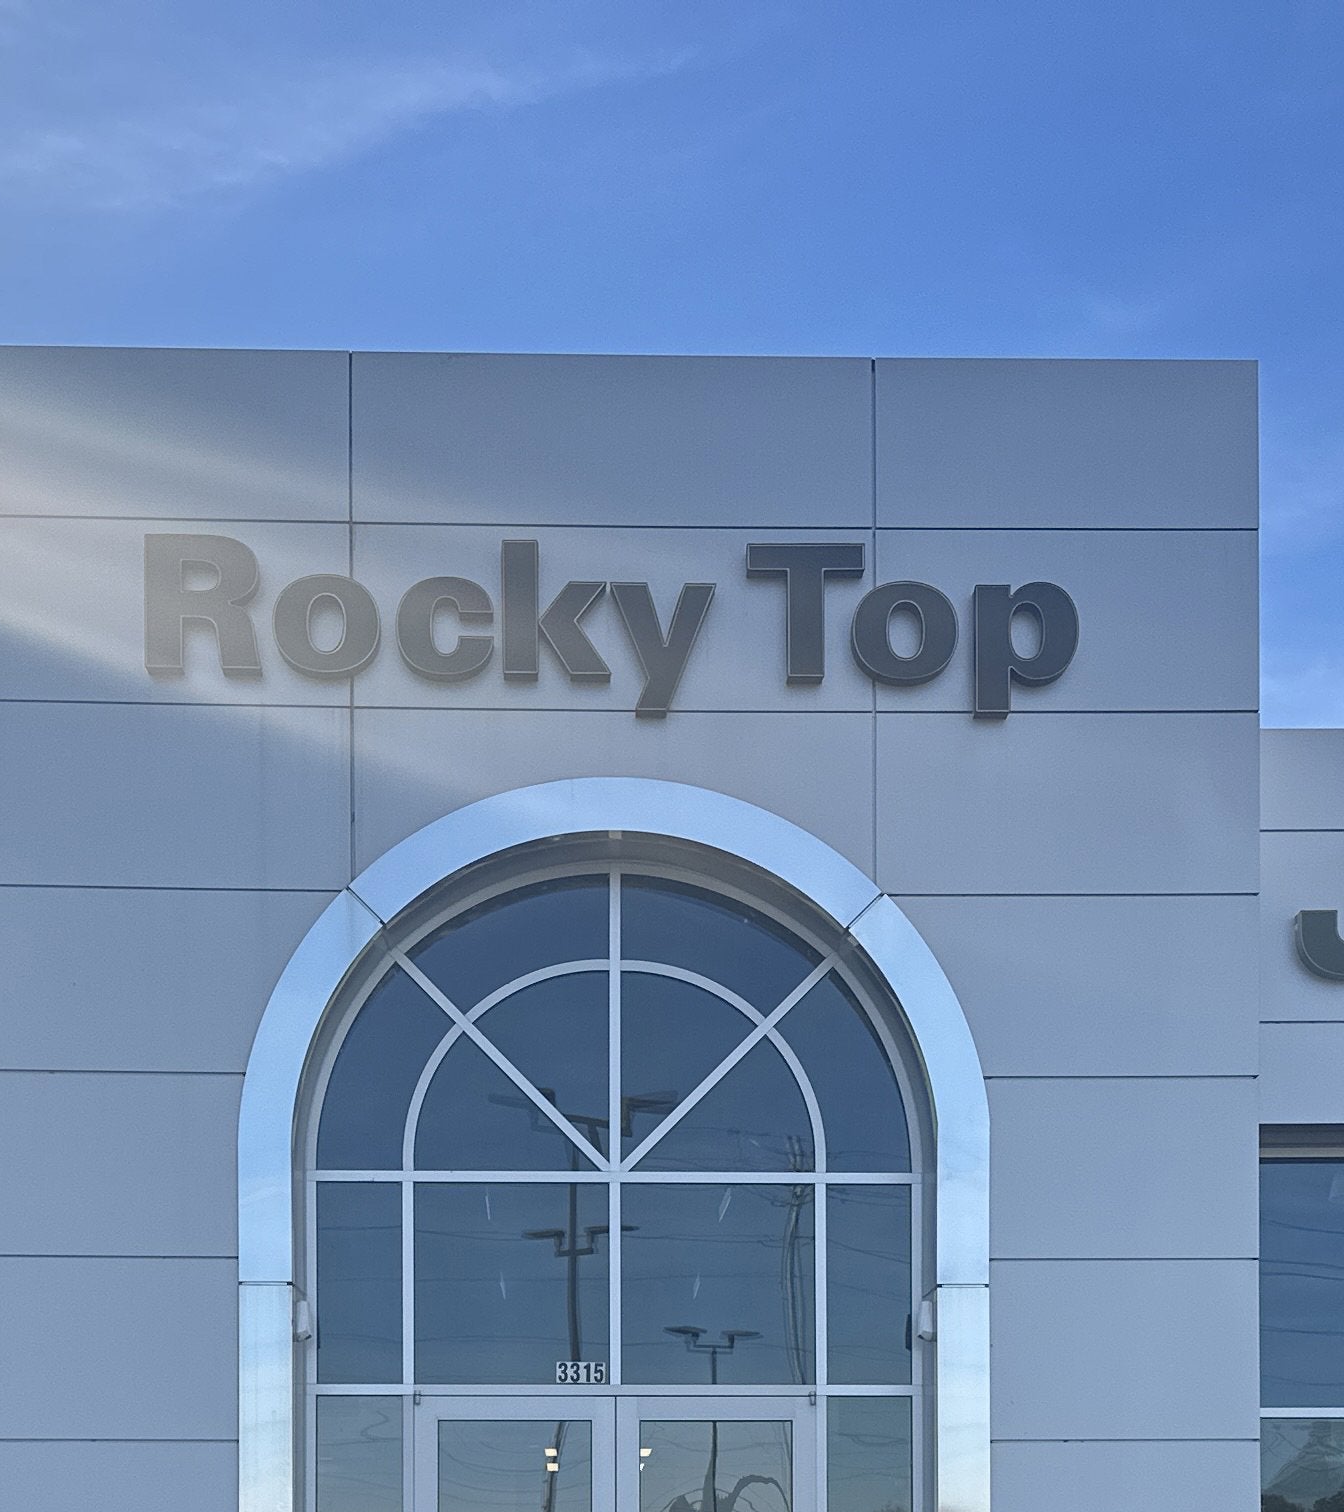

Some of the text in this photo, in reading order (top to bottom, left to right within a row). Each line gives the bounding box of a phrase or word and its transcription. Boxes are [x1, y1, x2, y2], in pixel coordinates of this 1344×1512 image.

[143, 532, 1080, 720] Rocky Top
[557, 1362, 605, 1383] 3315
